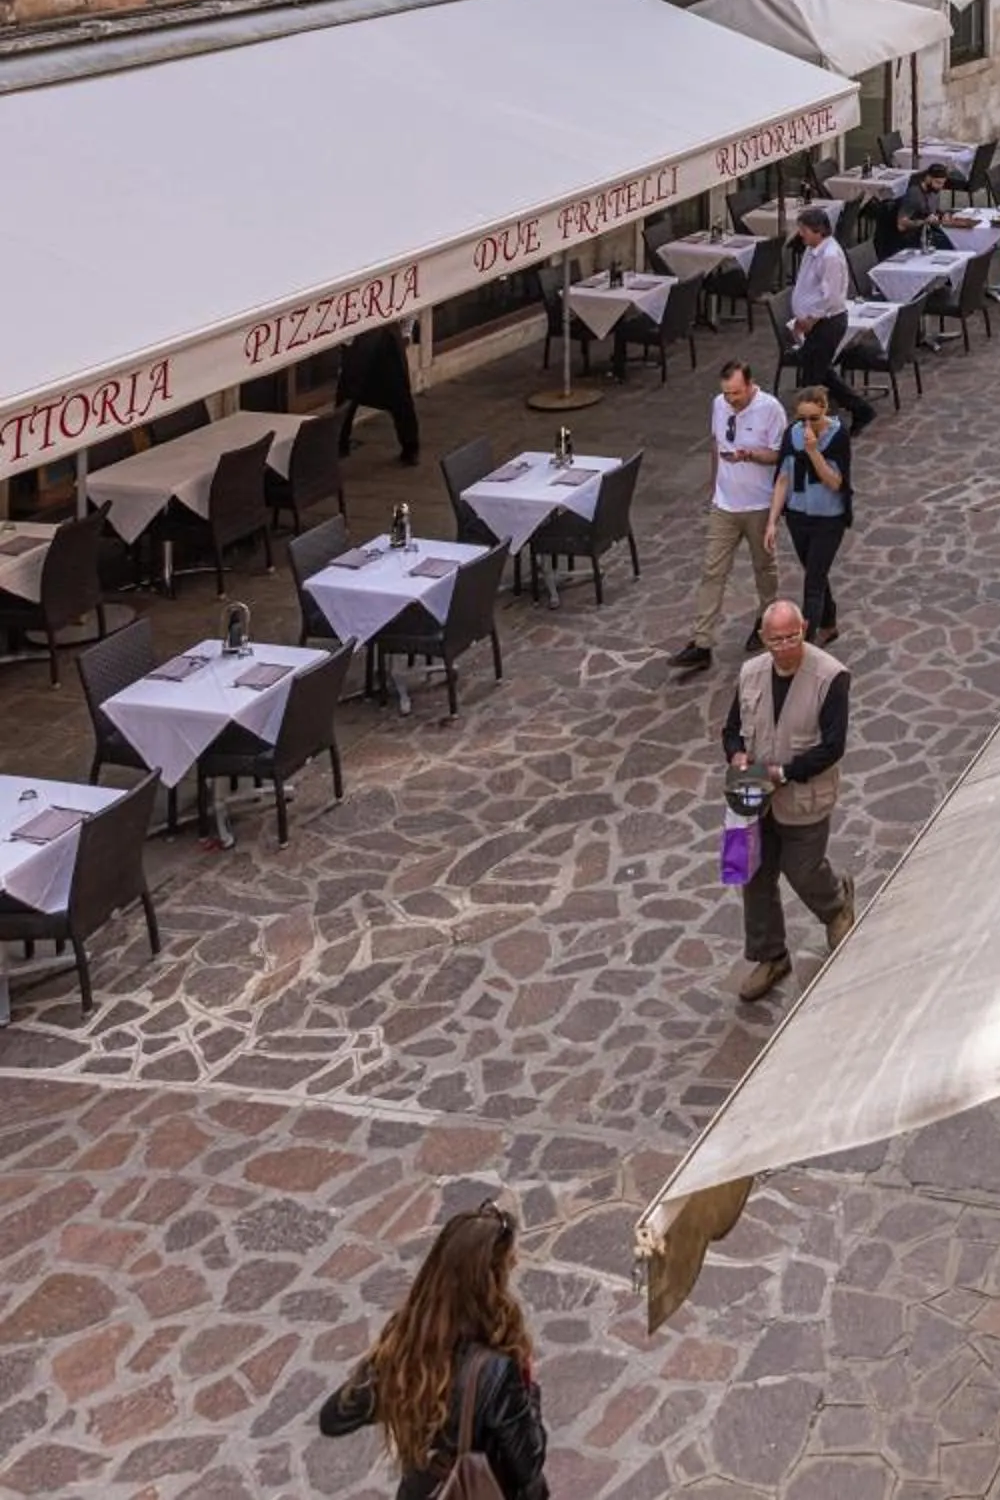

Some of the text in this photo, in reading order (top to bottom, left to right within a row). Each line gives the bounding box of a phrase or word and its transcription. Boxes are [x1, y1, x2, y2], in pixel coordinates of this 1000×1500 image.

[715, 105, 837, 176] RISTORANTE
[473, 164, 680, 272] DUE FRATELLI
[244, 260, 420, 364] PIZZERIA
[0, 358, 173, 462] TTORIA
